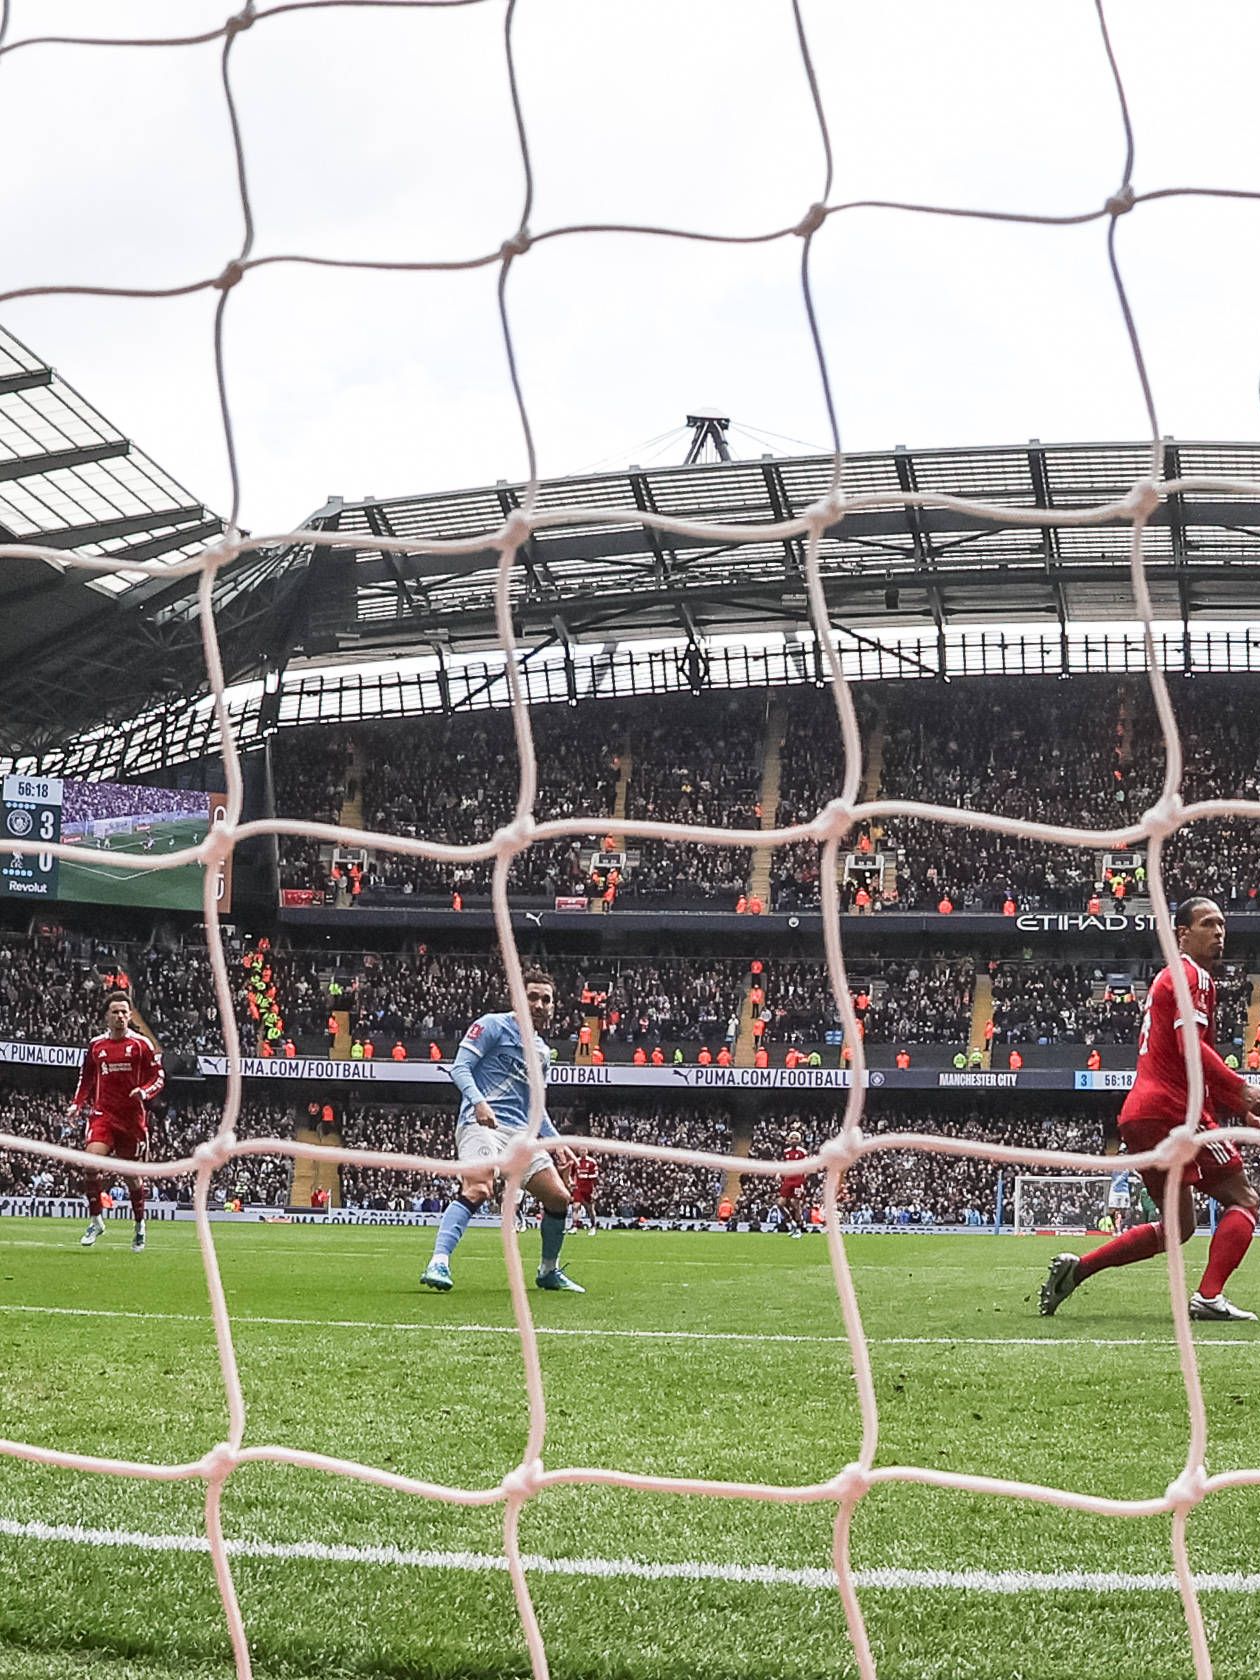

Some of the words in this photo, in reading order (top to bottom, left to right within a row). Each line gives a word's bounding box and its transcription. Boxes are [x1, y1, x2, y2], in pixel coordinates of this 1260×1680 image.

[18, 781, 49, 798] 56:18
[40, 811, 54, 840] 3
[9, 880, 48, 894] Revolut
[1016, 914, 1128, 931] ETIHAD
[225, 1059, 377, 1079] MA.COM/FOOTBALL
[695, 1068, 850, 1088] PUMA.COM/FOOTBALL
[939, 1073, 996, 1087] MANCHESTER
[997, 1073, 1017, 1087] CITY
[1080, 1074, 1088, 1087] 3
[1104, 1074, 1133, 1087] 56:18
